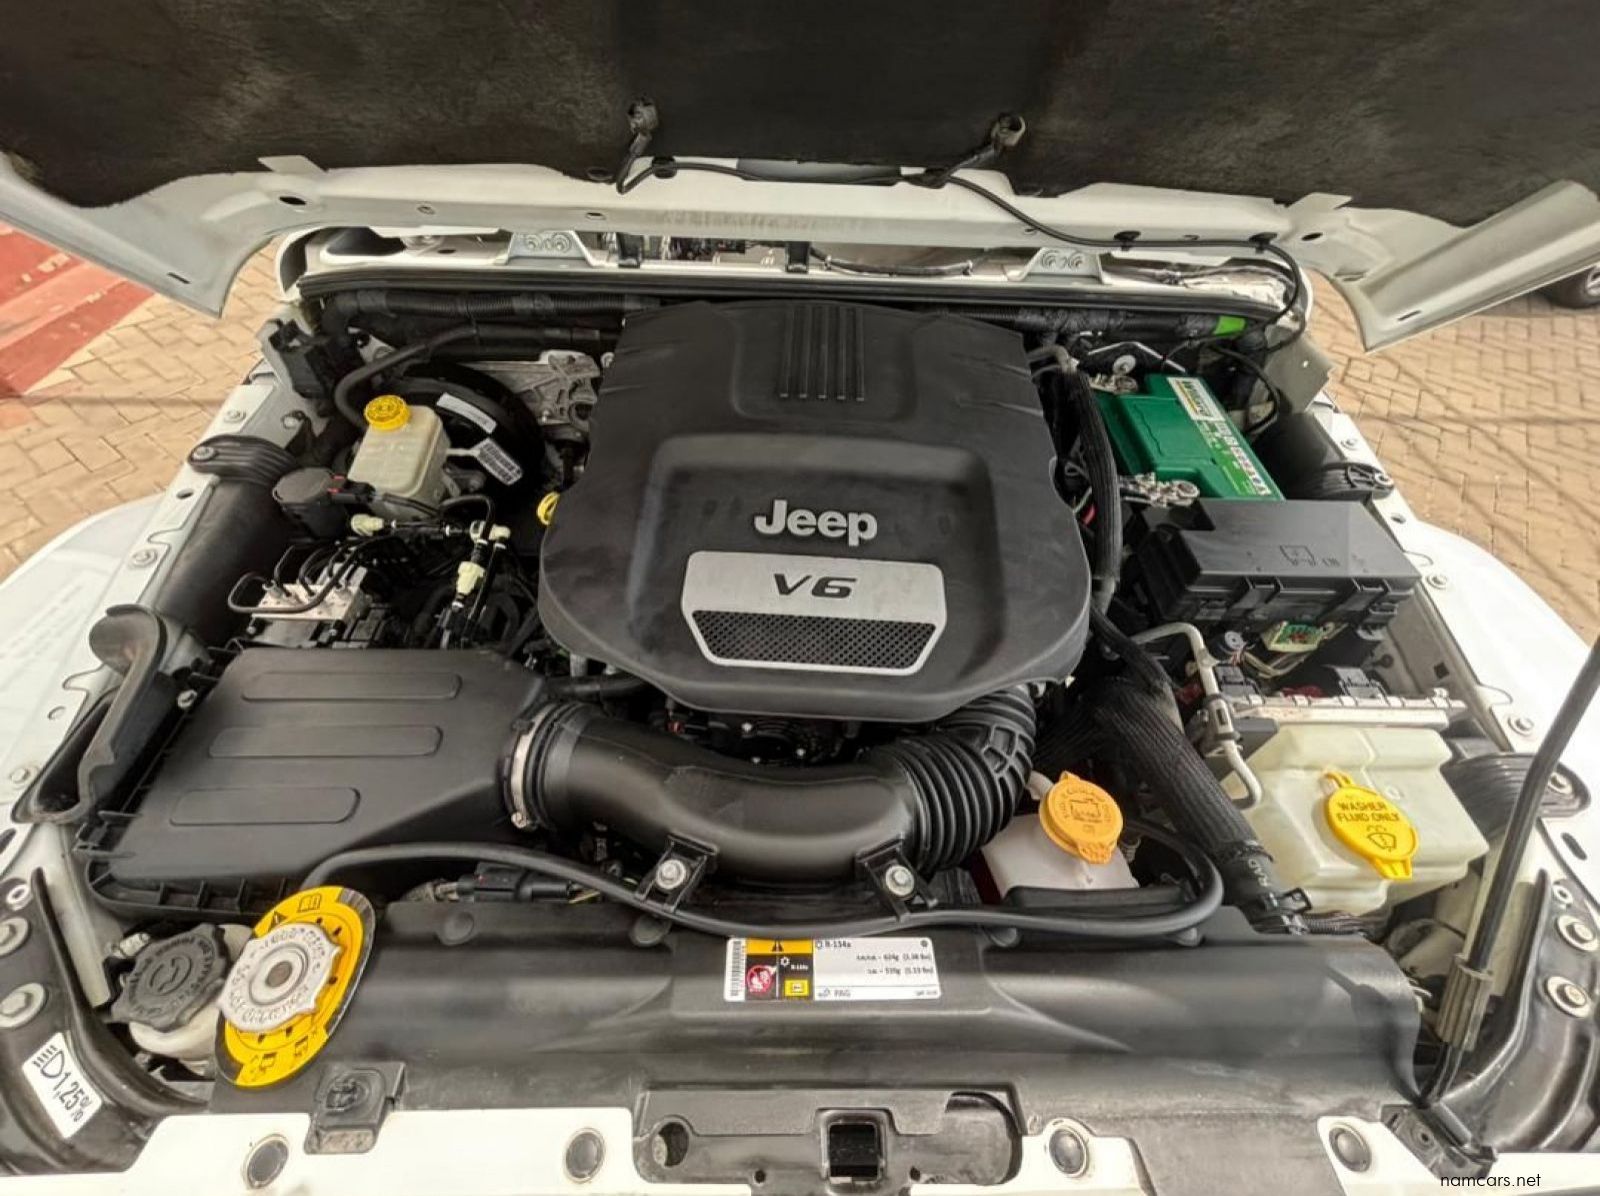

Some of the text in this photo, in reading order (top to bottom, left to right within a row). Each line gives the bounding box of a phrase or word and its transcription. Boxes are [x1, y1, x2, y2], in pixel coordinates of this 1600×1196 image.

[754, 499, 878, 547] Jeep
[774, 573, 857, 599] V6
[1337, 801, 1388, 811] WASHER
[1336, 812, 1400, 822] FLUID ONLY
